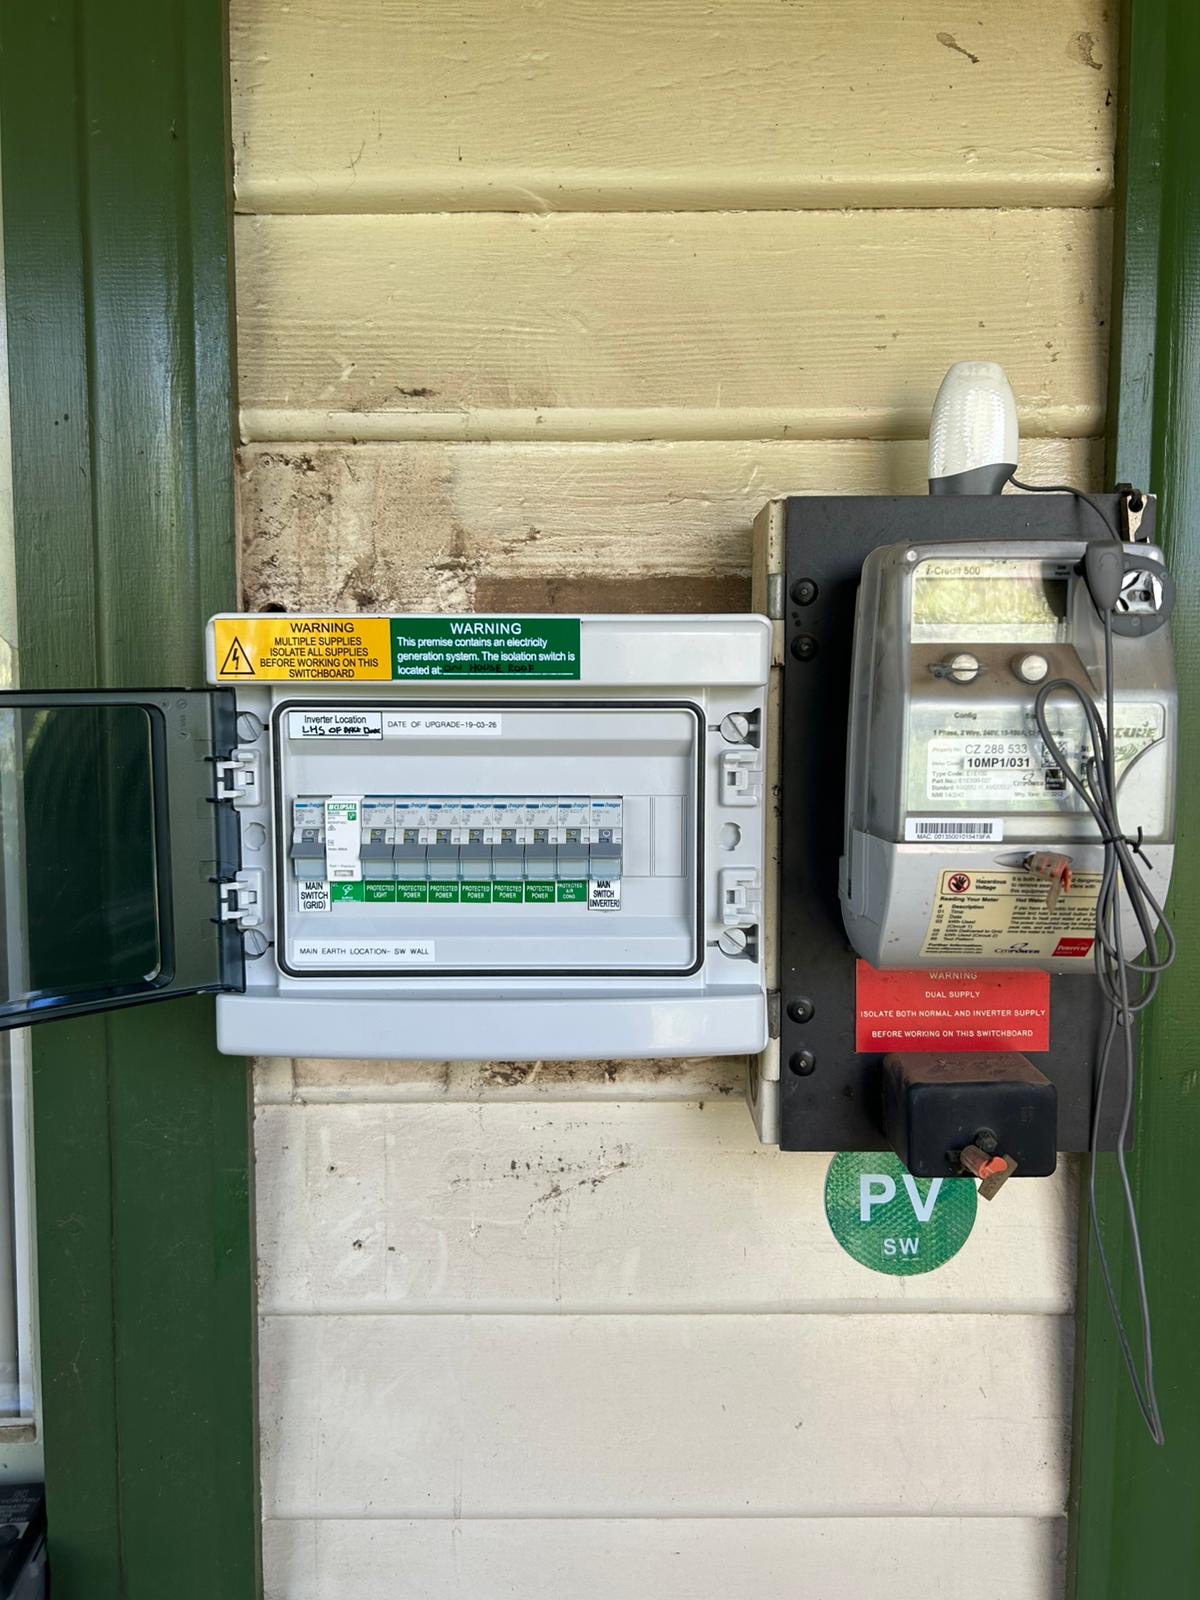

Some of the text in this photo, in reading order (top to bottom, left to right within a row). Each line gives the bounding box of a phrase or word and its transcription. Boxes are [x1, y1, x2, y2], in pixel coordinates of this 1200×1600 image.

[963, 566, 980, 575] 500
[290, 622, 354, 633] WARNING
[450, 622, 522, 634] WARNING
[275, 637, 362, 645] MULTIPLE SUPPLIES
[397, 636, 548, 649] This premise contains an electricity
[270, 648, 368, 656] ISOLATE ALL SUPPLIES
[397, 651, 575, 663] generation system. The isolation switch is
[260, 658, 378, 667] BEFORE WORKING ON THIS
[398, 665, 442, 675] located at:
[470, 664, 502, 673] HOUSE
[508, 664, 535, 673] ROOF
[289, 669, 354, 678] SWITCHBOARD
[304, 715, 366, 724] Inverter Location
[954, 712, 977, 720] Config
[965, 744, 981, 754] CZ
[984, 744, 1005, 754] 288
[1008, 744, 1028, 754] 533
[968, 758, 1030, 768] 10MP1/031
[305, 882, 323, 890] MAIN
[301, 891, 328, 900] SWITCH
[593, 890, 614, 898] SWITCH
[303, 901, 326, 910] (GRID)
[590, 899, 620, 908] (INVERTER)
[929, 972, 978, 980] WARNING
[860, 1174, 944, 1222] PV
[884, 1238, 919, 1256] SW
